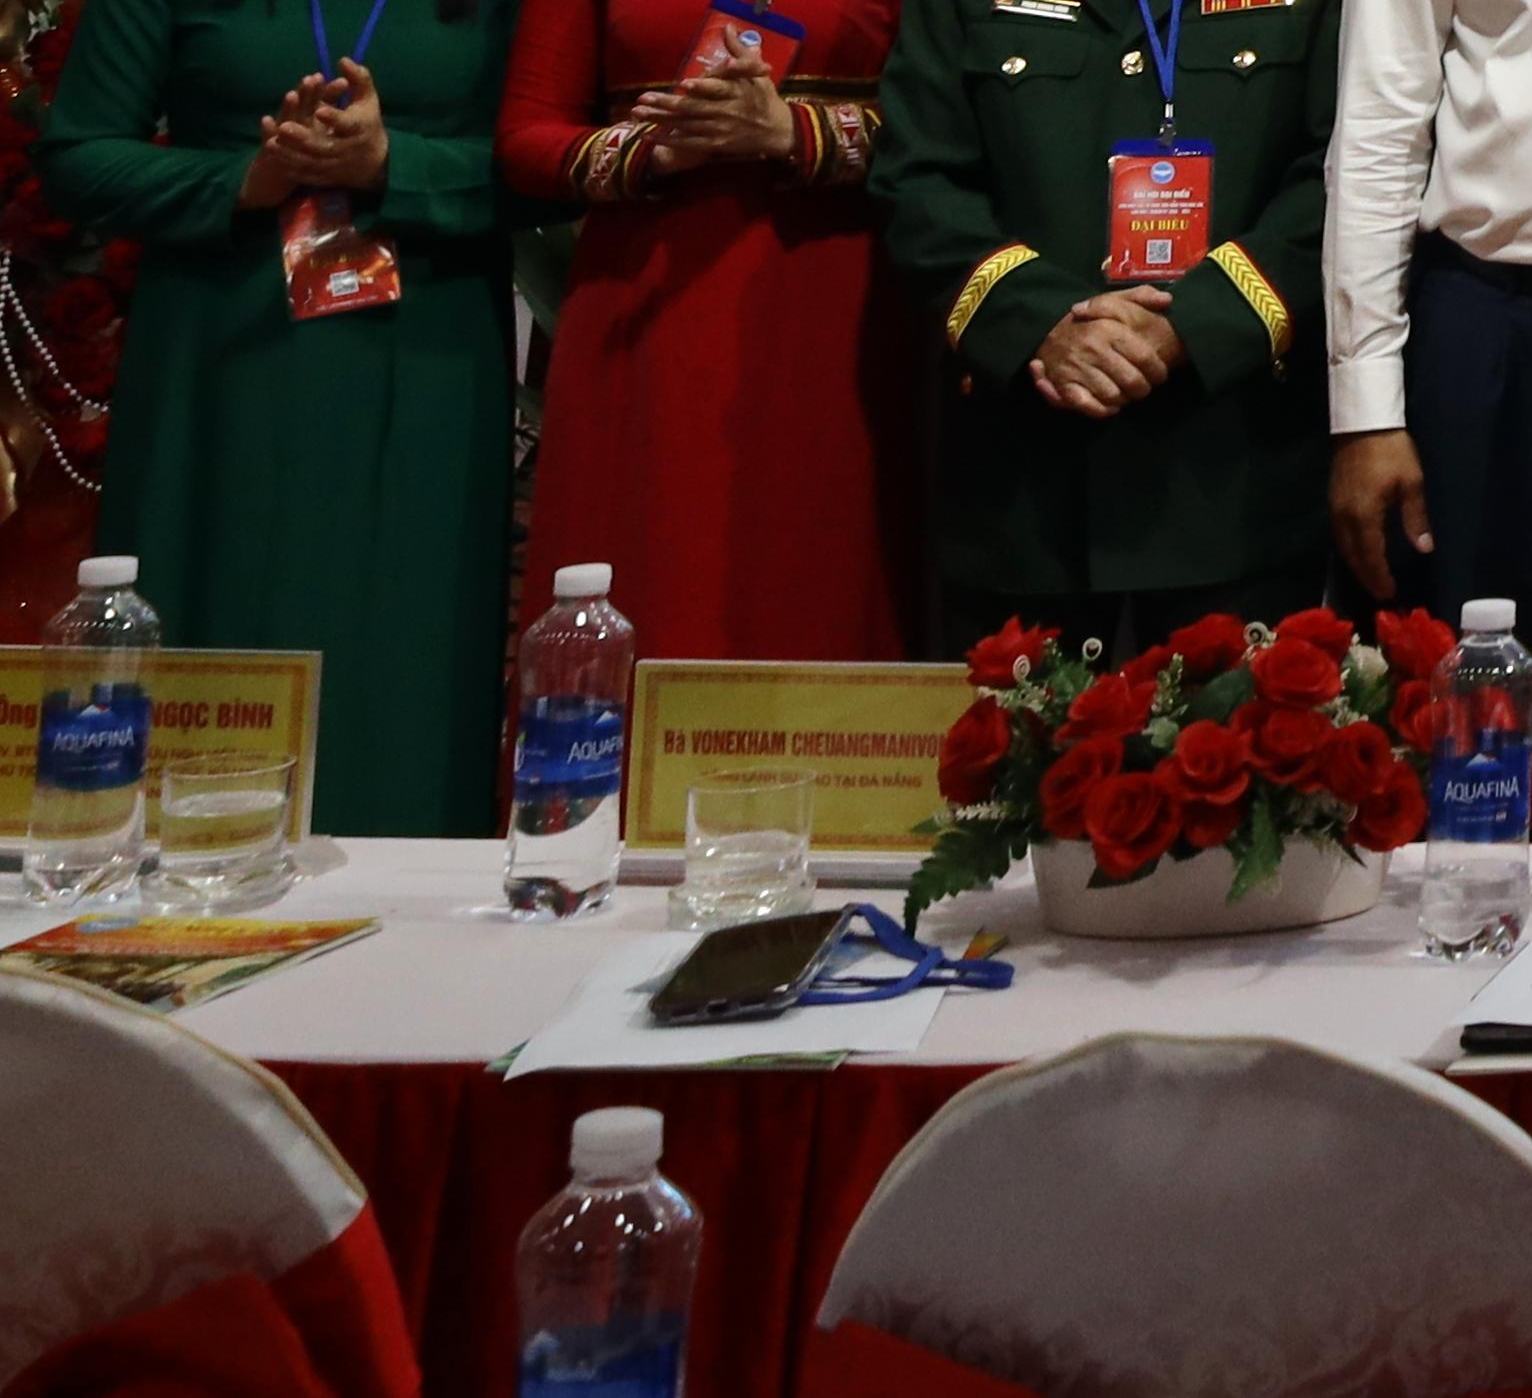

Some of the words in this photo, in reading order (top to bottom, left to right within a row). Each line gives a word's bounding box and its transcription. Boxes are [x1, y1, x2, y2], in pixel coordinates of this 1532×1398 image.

[53, 725, 136, 753] AQUAFINA
[692, 730, 786, 757] VONEKHAM
[1444, 775, 1520, 804] AQUAFINA
